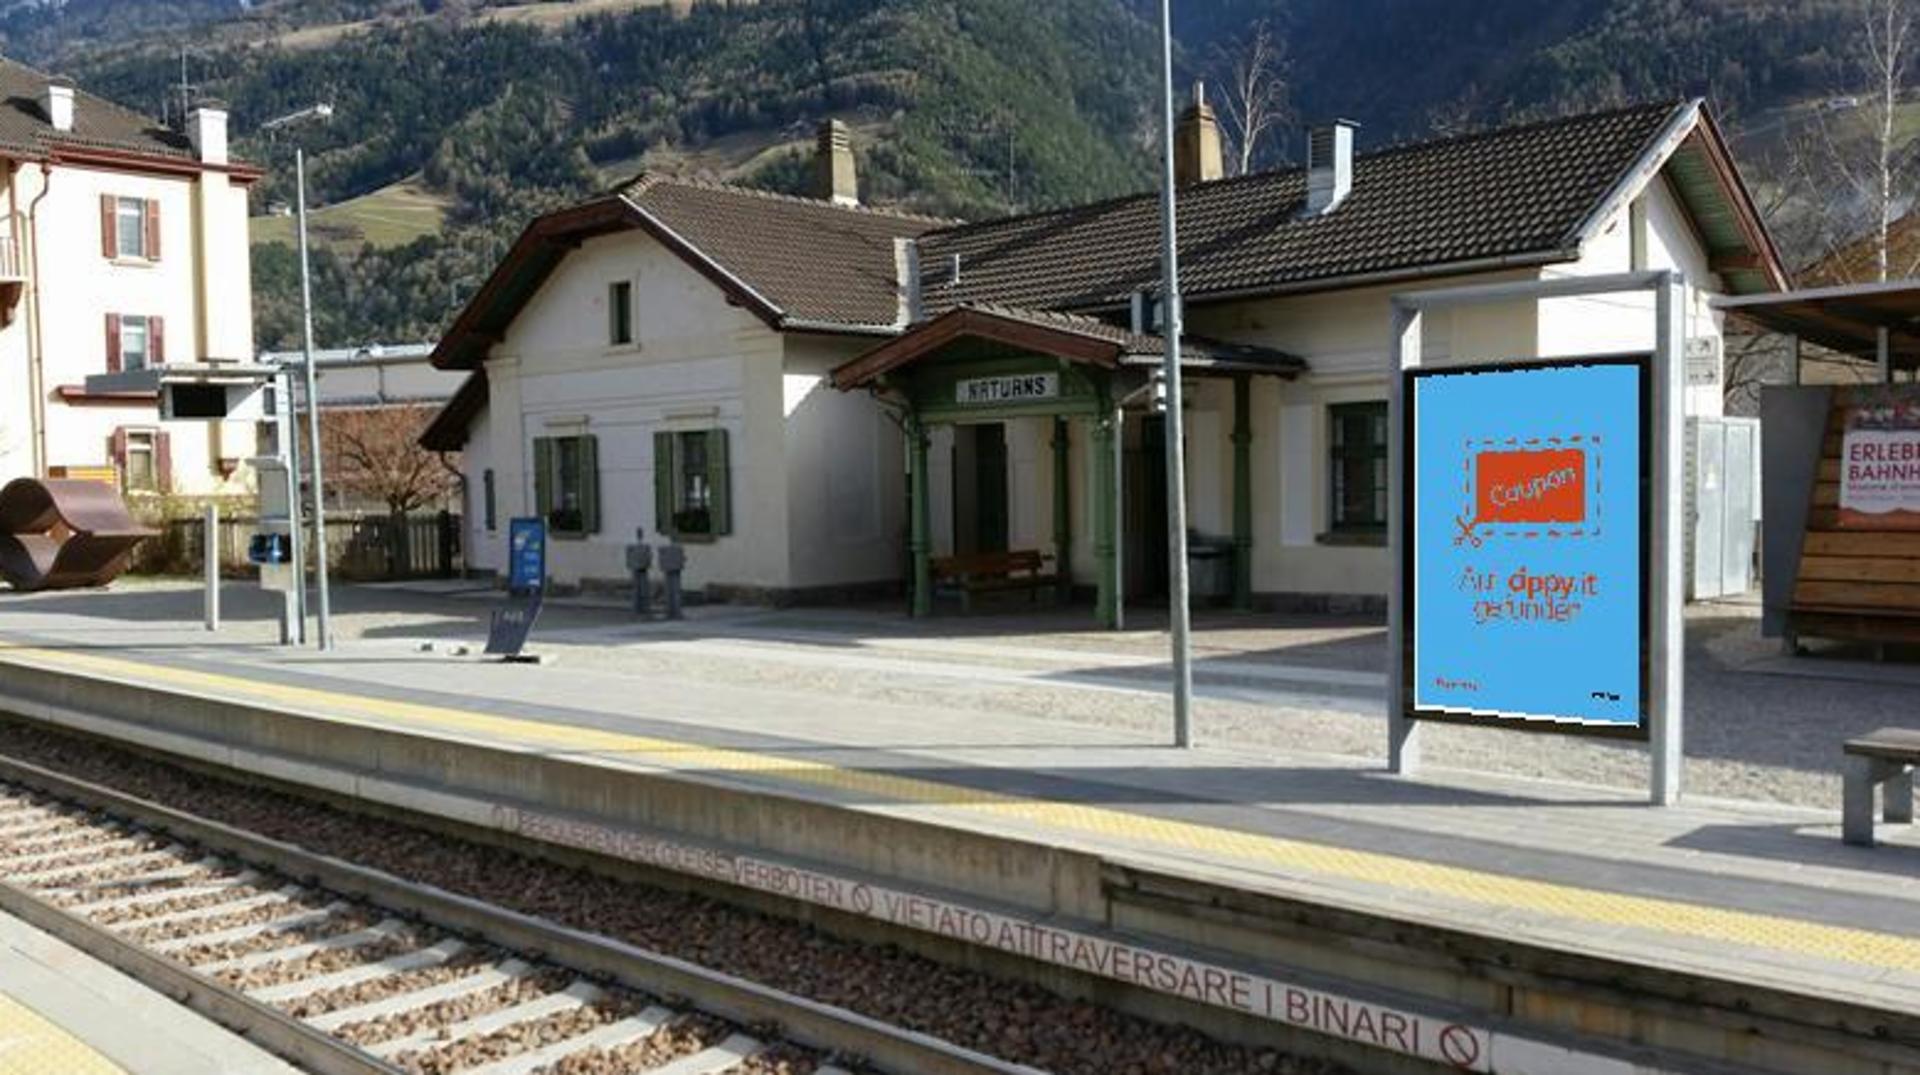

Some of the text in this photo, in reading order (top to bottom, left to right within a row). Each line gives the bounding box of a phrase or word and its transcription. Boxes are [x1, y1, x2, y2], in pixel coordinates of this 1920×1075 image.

[968, 376, 1046, 400] NATURNS
[1850, 443, 1920, 461] ERLEB
[1490, 467, 1576, 508] Coupon
[734, 856, 843, 906] VERBOTEN
[885, 893, 991, 942] VIETATO
[1264, 984, 1273, 1015] I
[1286, 990, 1420, 1053] BINARI
